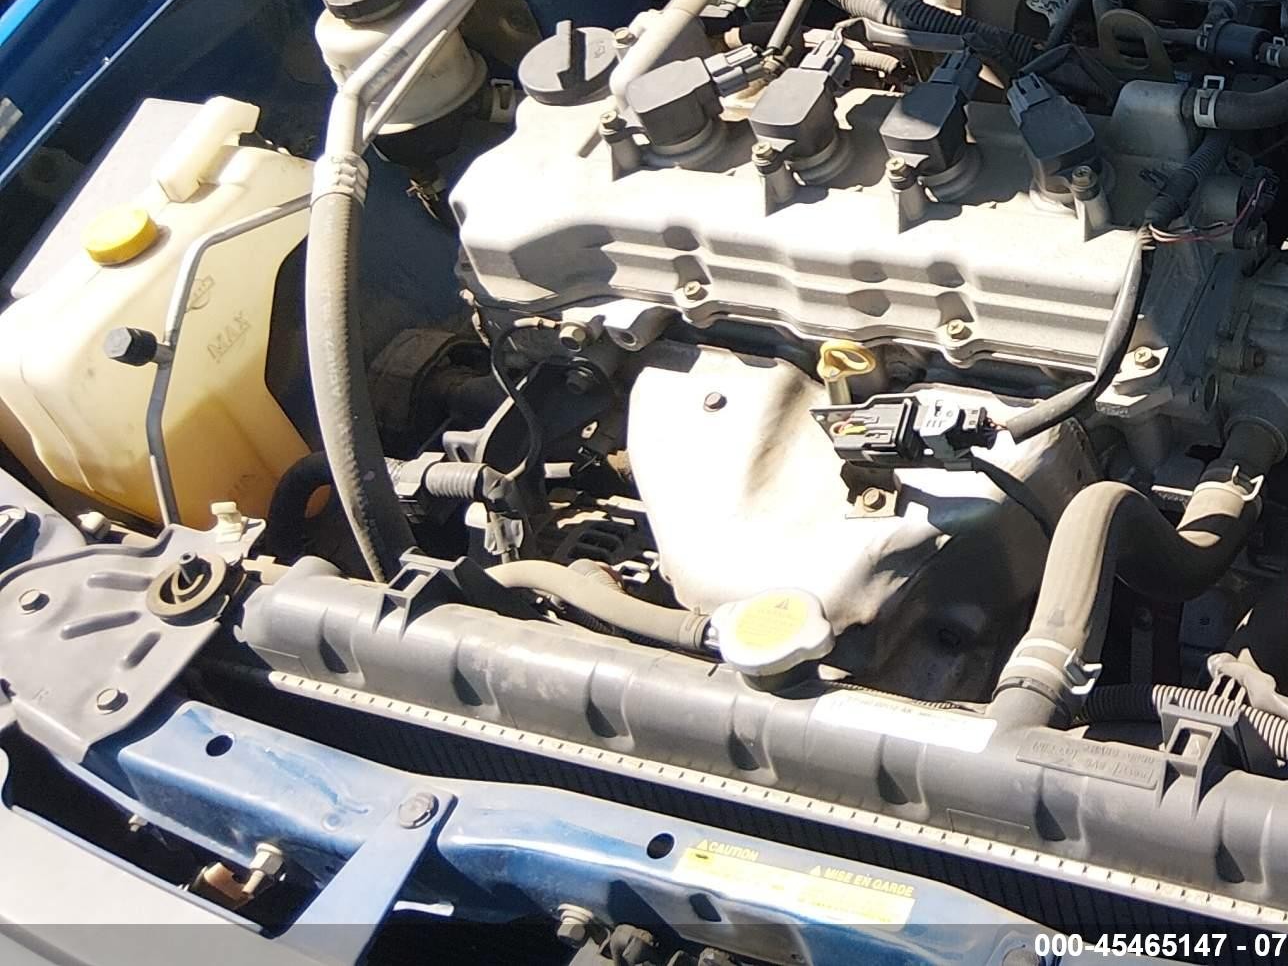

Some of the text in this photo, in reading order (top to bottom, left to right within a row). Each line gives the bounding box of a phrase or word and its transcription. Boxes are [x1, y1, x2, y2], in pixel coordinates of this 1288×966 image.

[708, 842, 760, 862] CAUTION
[823, 867, 915, 898] MISE EN GARDE
